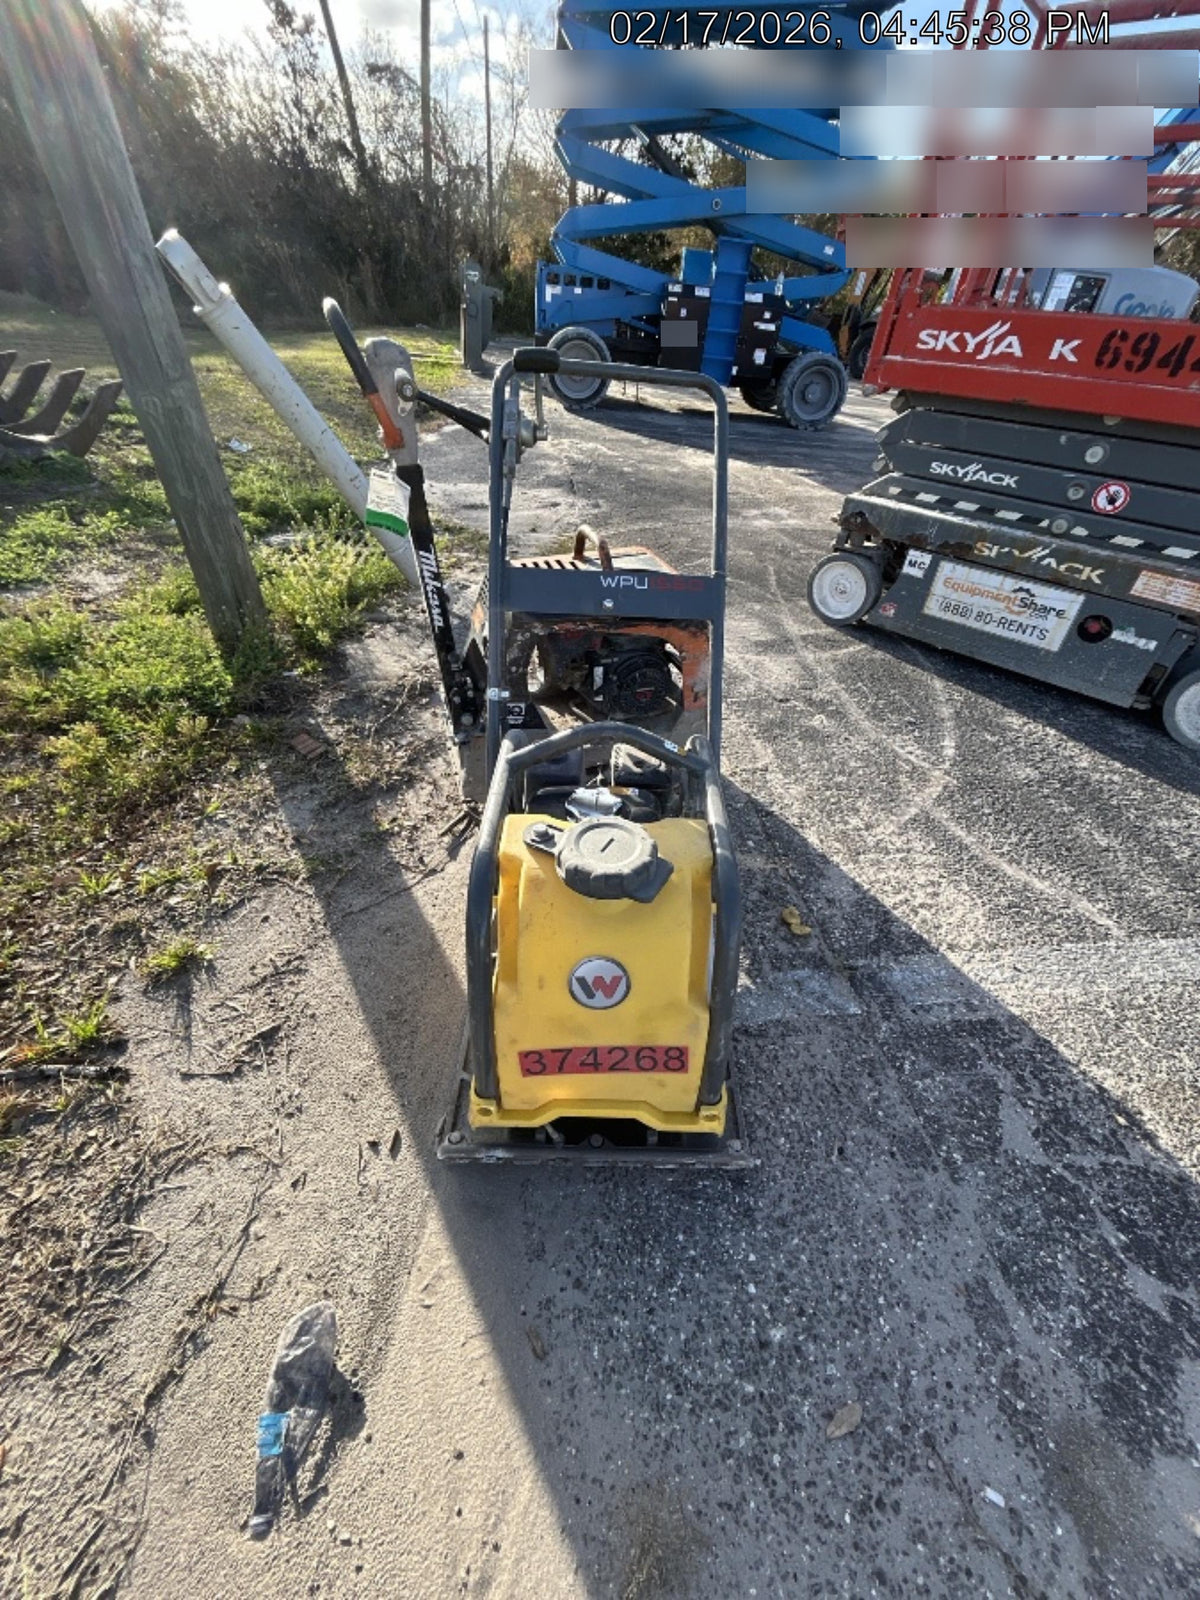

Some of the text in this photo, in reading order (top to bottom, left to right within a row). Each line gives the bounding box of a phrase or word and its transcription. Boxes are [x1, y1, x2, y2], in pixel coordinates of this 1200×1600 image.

[929, 461, 1019, 488] SKYJACK
[942, 576, 1067, 620] EquipmentShare
[938, 599, 1050, 641] (888) 80-RENTS
[524, 1046, 687, 1076] 374268
